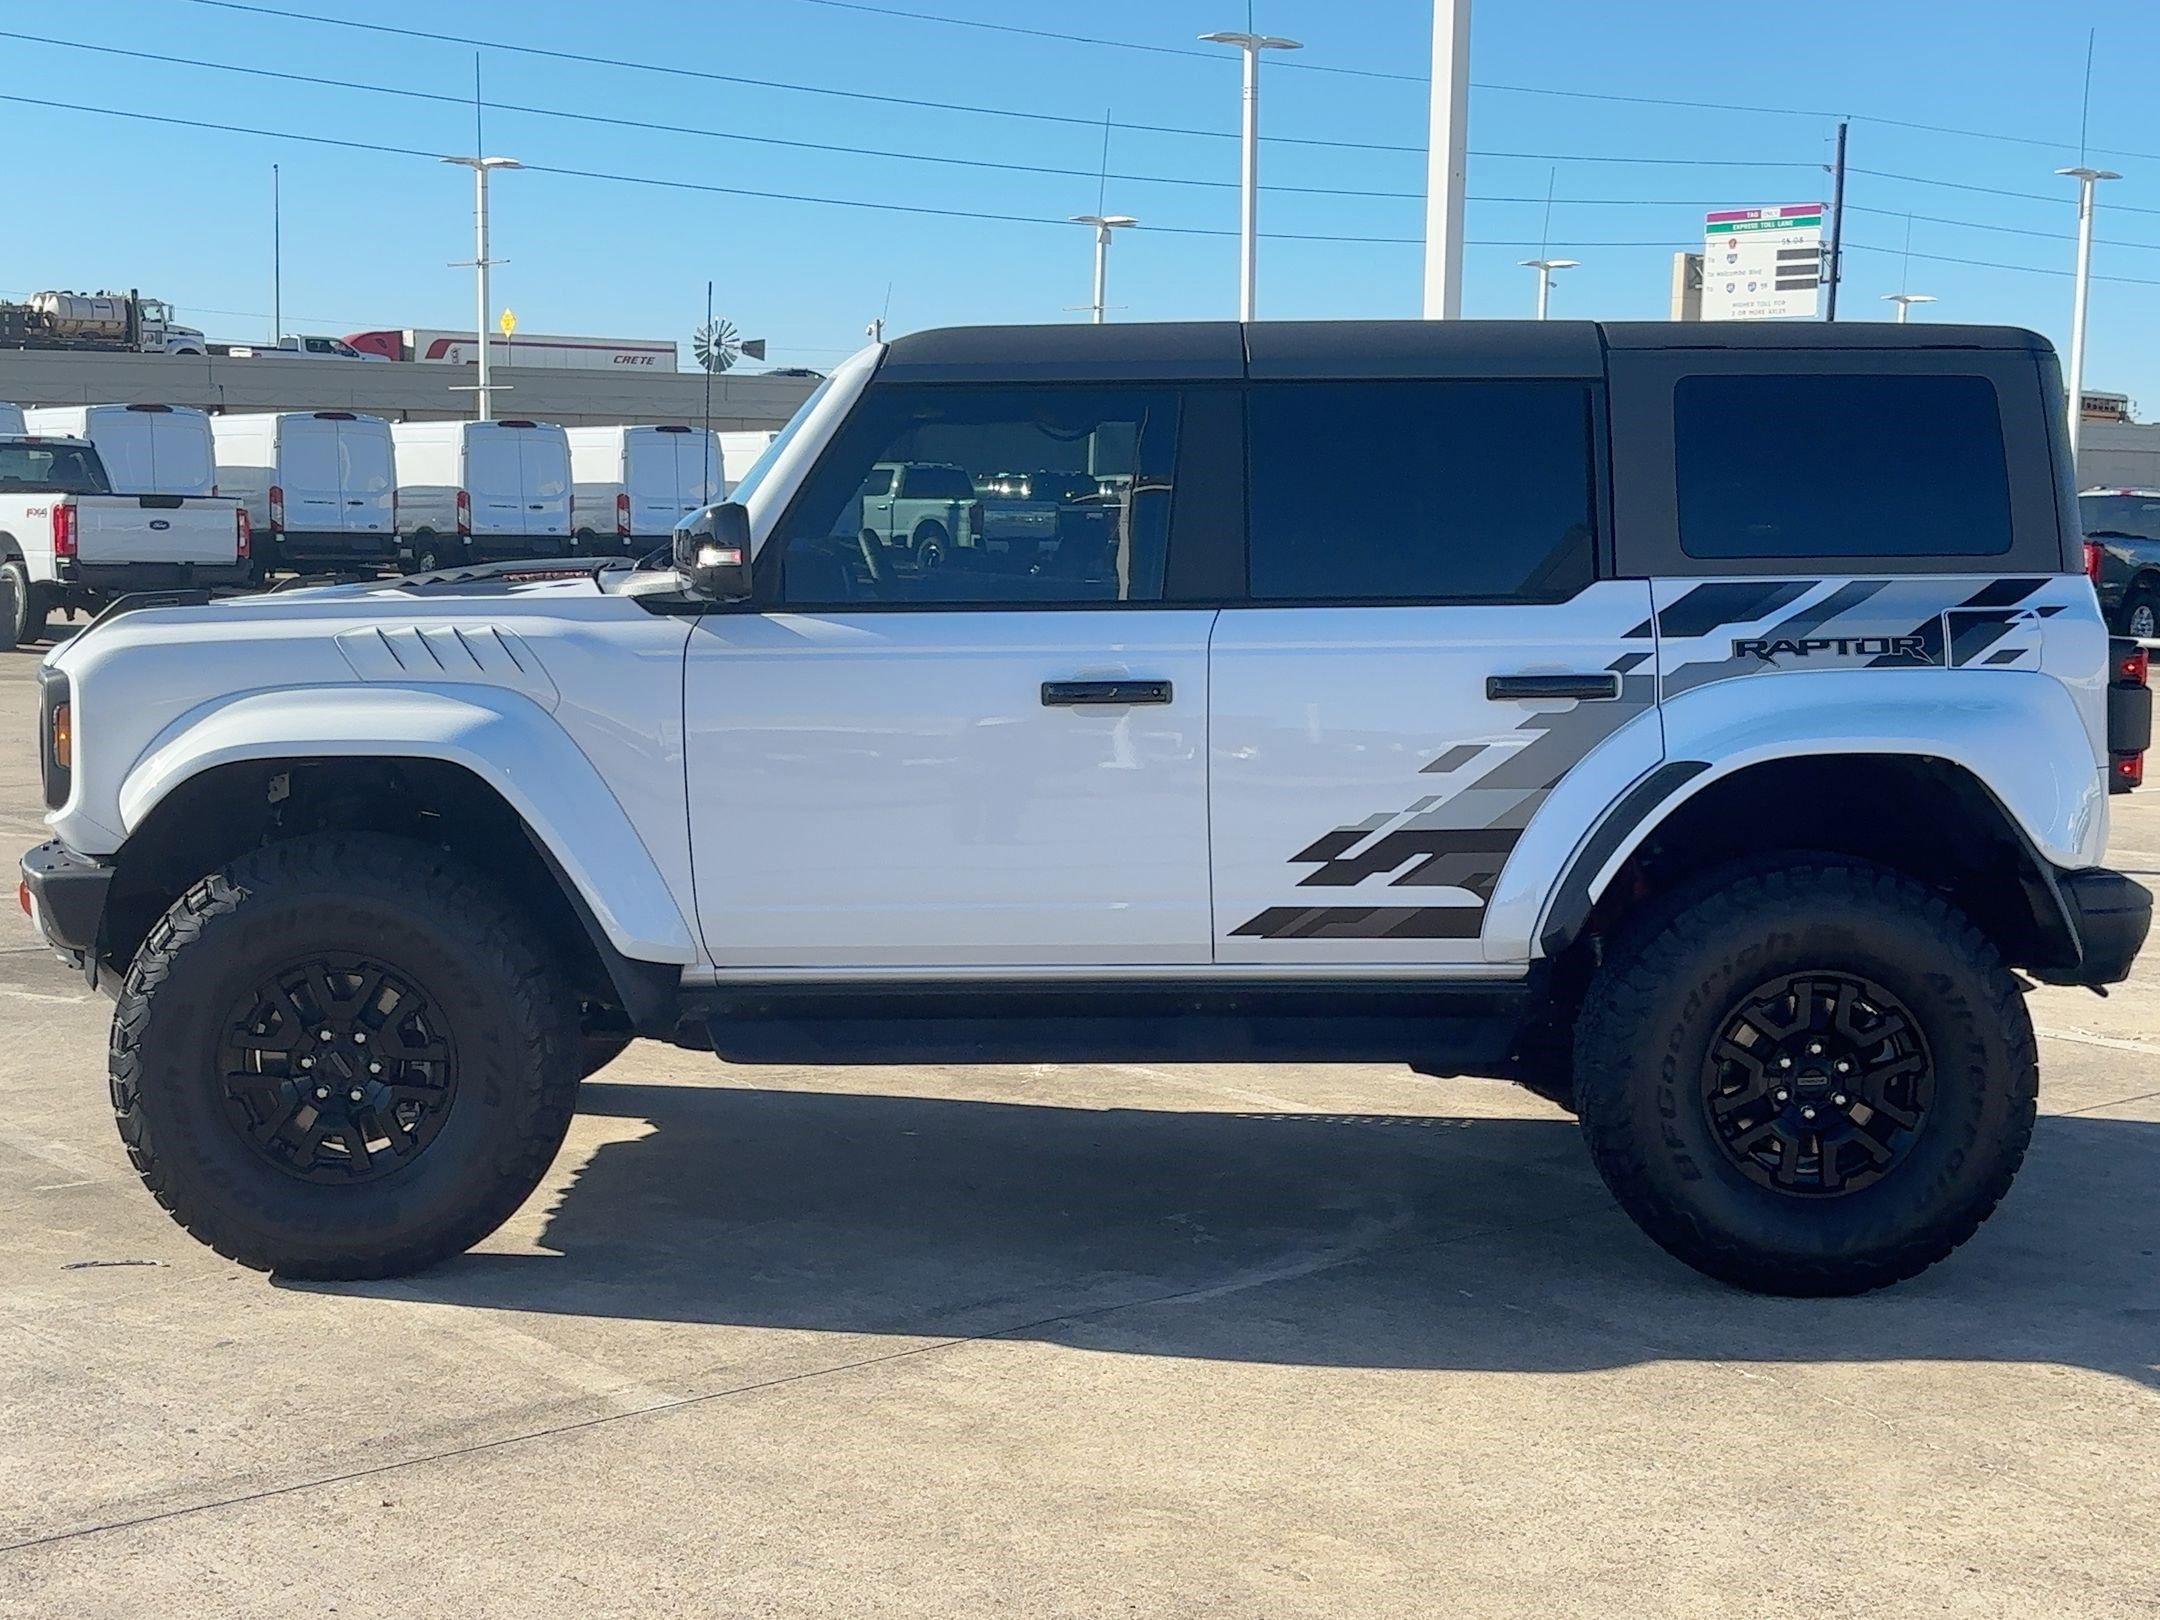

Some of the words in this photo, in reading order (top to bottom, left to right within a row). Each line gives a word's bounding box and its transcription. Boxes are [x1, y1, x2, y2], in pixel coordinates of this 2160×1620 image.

[1746, 211, 1759, 219] TAG
[1760, 221, 1775, 229] TOLL
[1777, 219, 1793, 228] LANE
[613, 355, 656, 366] CRETE
[1731, 635, 1936, 668] RAPTOR
